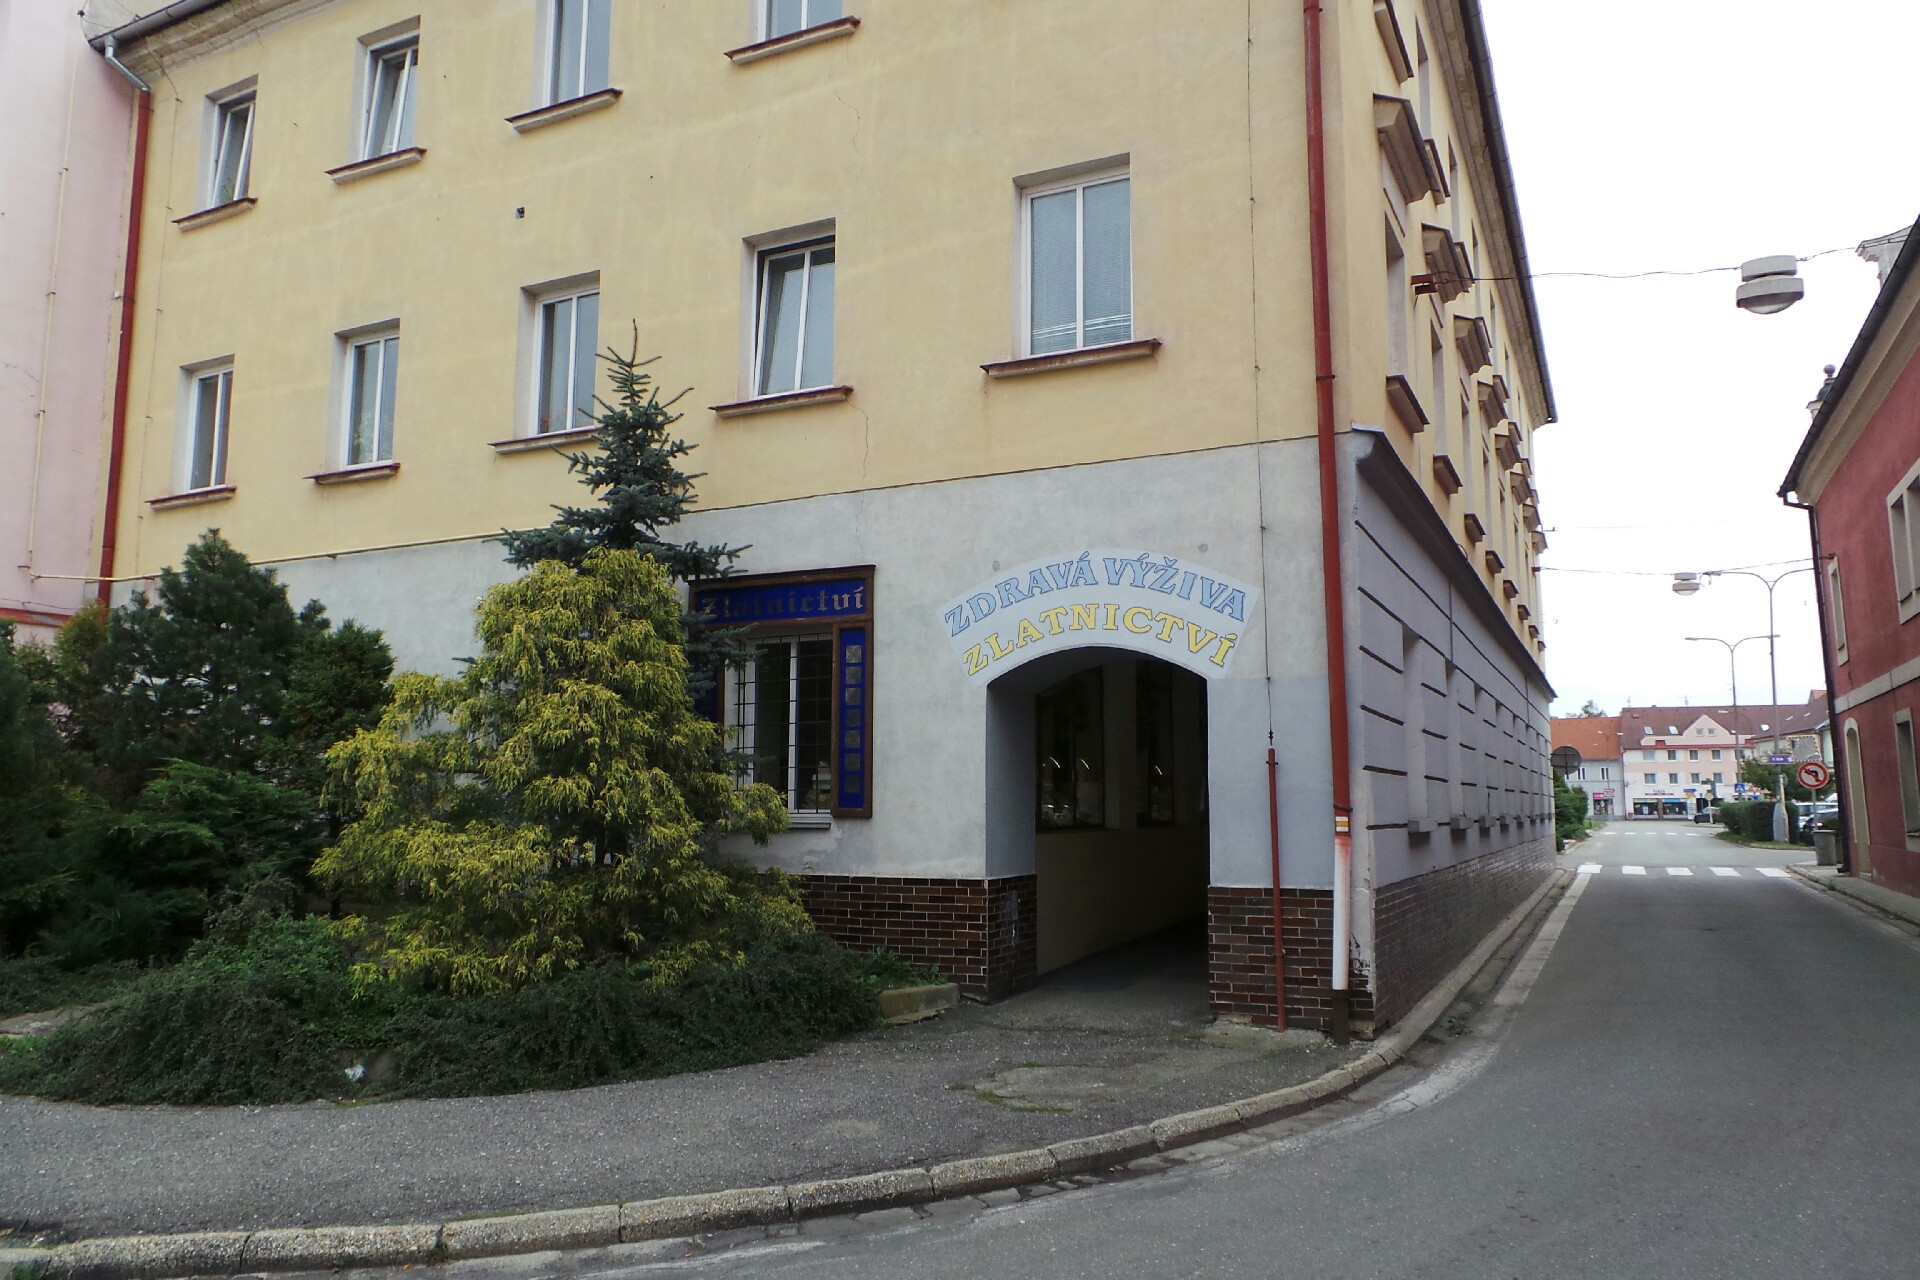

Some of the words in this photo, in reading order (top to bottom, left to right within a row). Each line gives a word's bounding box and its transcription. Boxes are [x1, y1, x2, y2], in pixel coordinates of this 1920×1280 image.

[944, 551, 1099, 637] ZDRAVÁ
[1103, 553, 1246, 622] VÝŽIVA
[962, 603, 1238, 676] ZLATNICTVÍ
